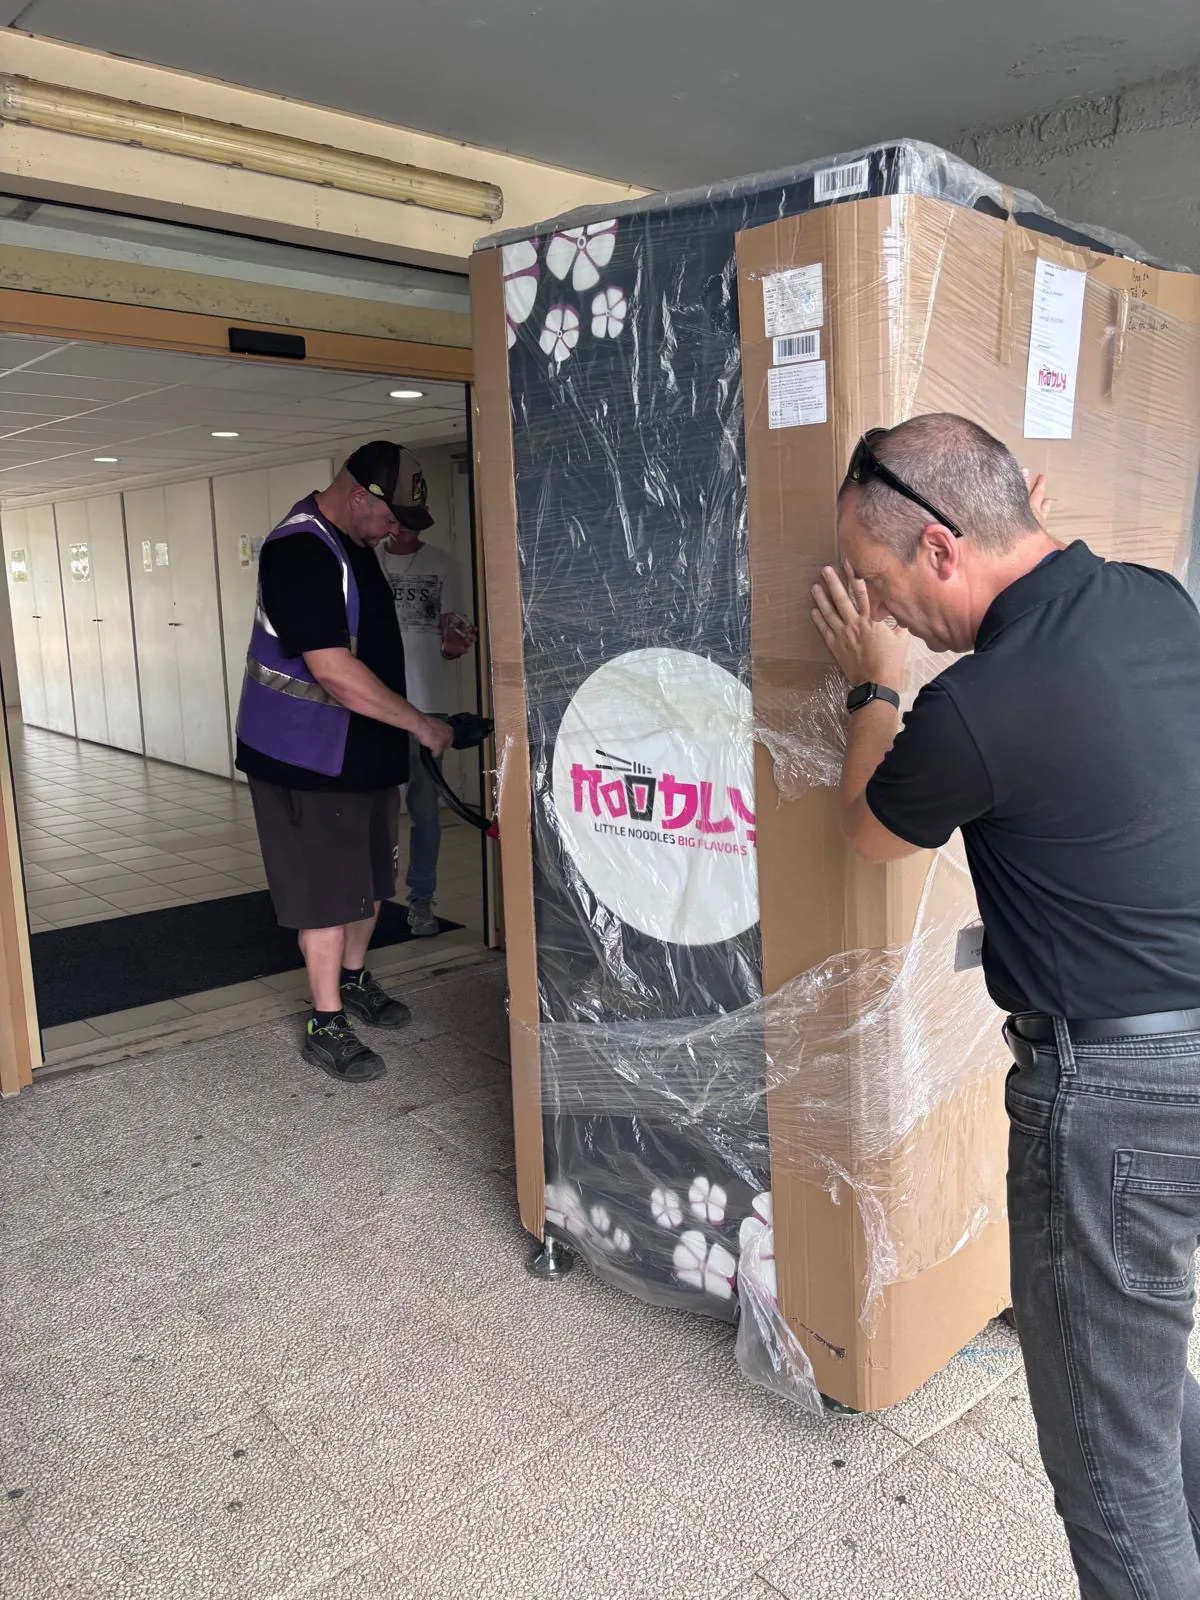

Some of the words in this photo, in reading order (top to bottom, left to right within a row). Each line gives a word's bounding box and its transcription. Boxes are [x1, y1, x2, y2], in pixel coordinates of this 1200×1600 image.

[393, 588, 430, 602] ESS
[594, 823, 626, 837] LITTLE
[628, 829, 676, 845] NOODLES
[677, 835, 695, 848] BIG
[698, 839, 748, 857] FLAVORS
